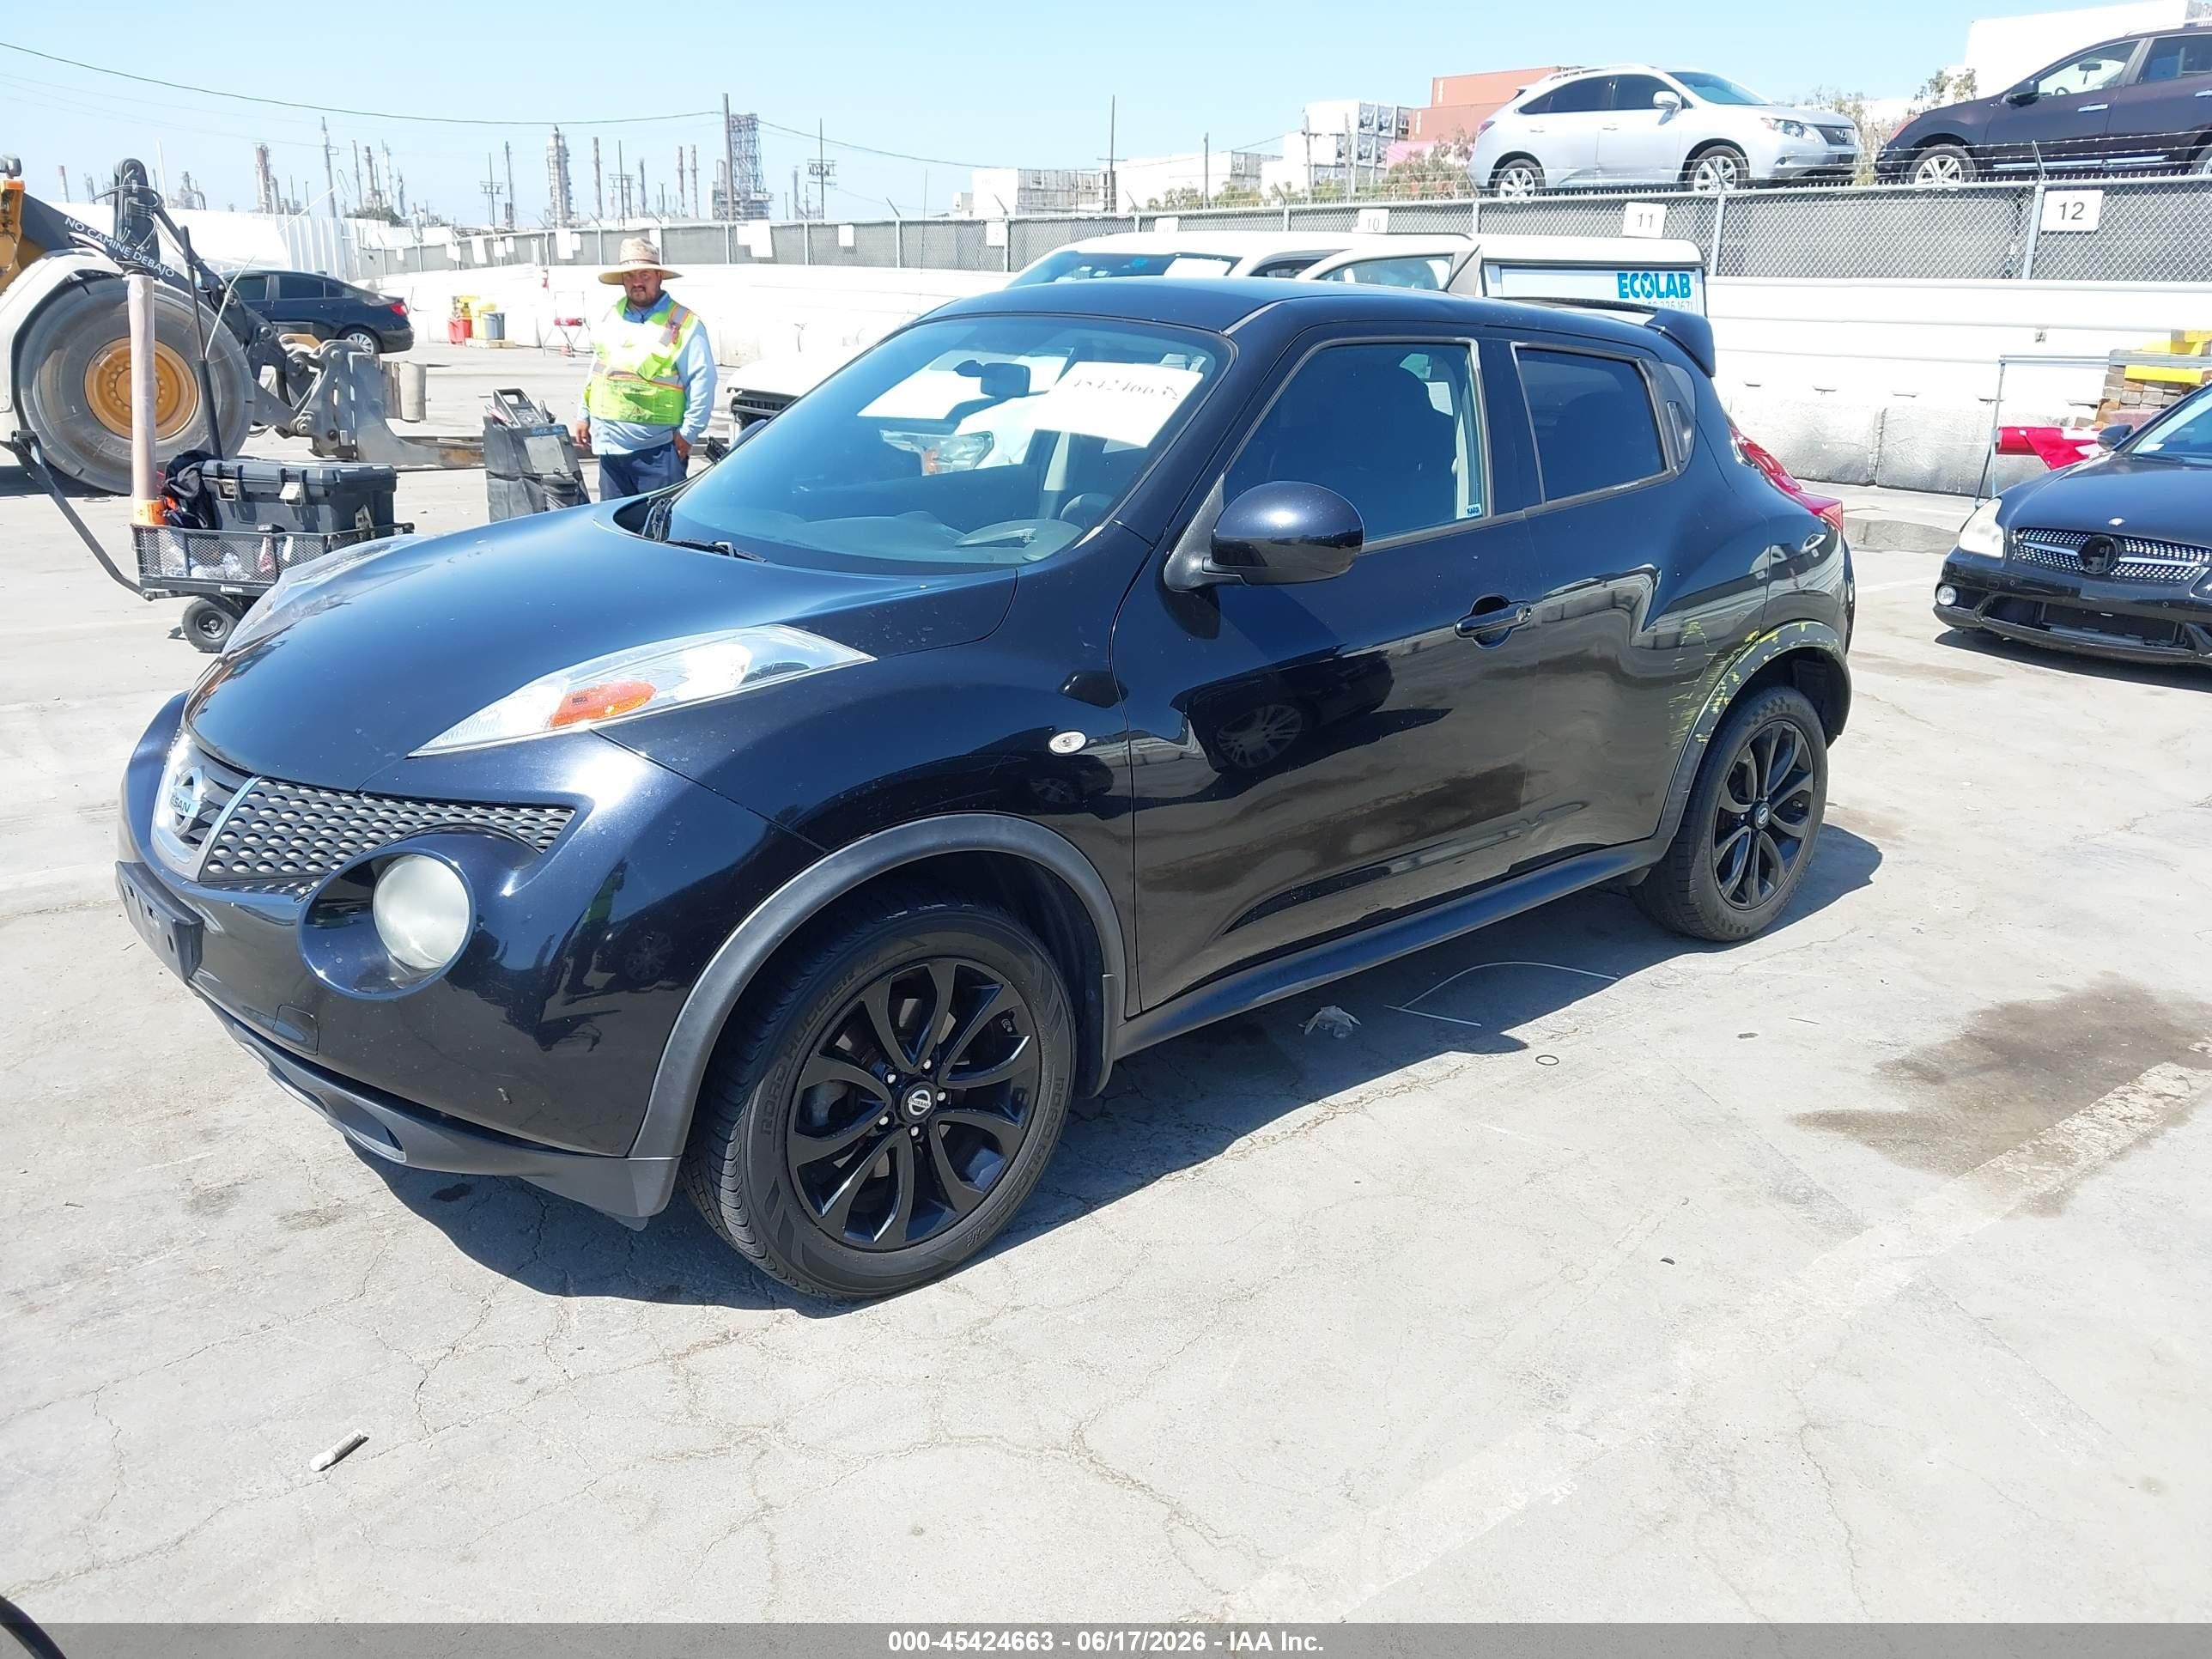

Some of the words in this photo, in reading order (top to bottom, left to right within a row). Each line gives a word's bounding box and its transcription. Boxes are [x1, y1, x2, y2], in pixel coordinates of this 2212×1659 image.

[2059, 202, 2085, 220] 12
[1367, 217, 1380, 231] 10
[1638, 213, 1653, 228] 11
[64, 217, 85, 231] NO
[87, 228, 131, 256] CAMINE
[132, 251, 174, 277] DEBAJO
[1617, 272, 1692, 299] ECOLAB
